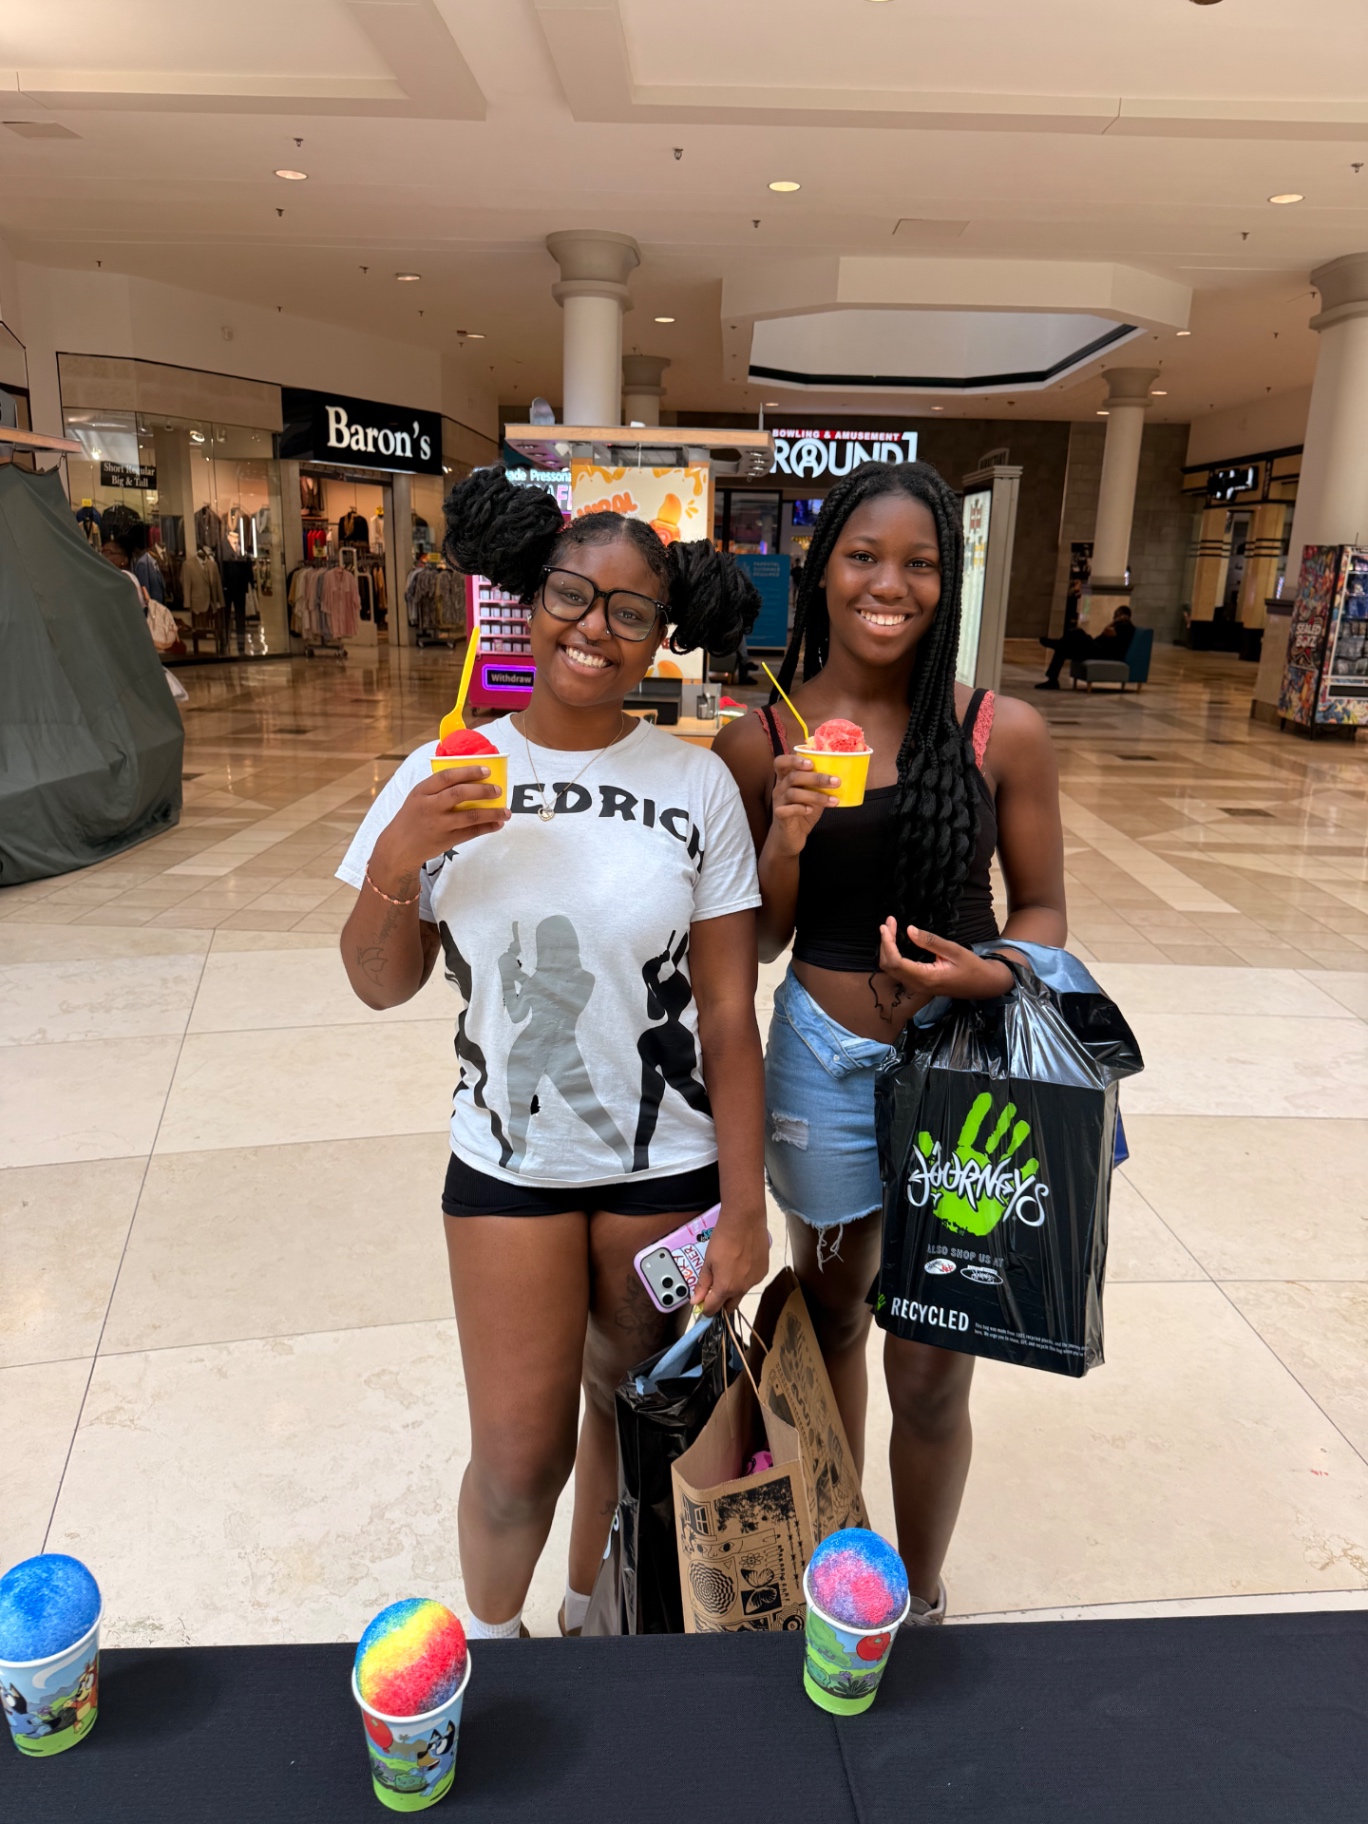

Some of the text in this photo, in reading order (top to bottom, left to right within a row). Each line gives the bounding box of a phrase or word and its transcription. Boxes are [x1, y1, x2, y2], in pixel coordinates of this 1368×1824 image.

[325, 405, 431, 460] Baron's
[772, 428, 900, 441] BOWLING & AMUSEMENT
[103, 462, 124, 473] Short
[111, 475, 148, 487] Big & Tall
[1296, 623, 1321, 635] SEALED
[491, 673, 532, 684] Withdraw
[907, 1140, 1050, 1228] JOURNEYS
[927, 1243, 1004, 1268] ALSO SHOP US AT
[890, 1296, 970, 1332] RECYCLED
